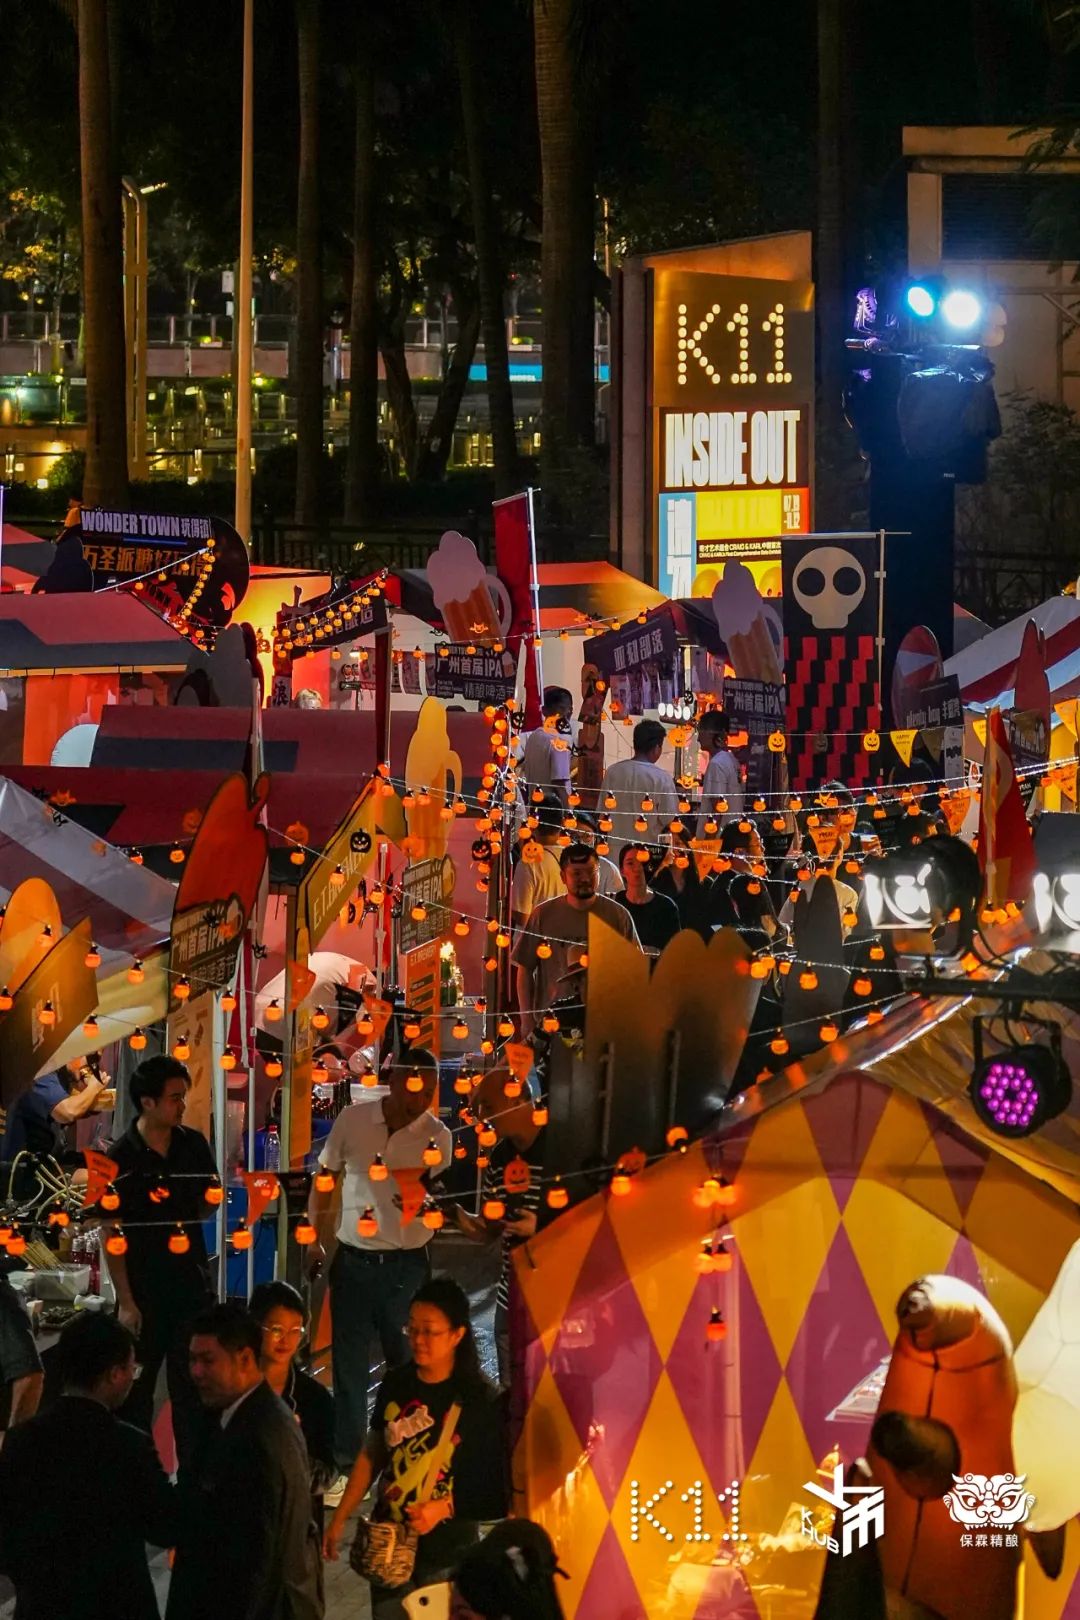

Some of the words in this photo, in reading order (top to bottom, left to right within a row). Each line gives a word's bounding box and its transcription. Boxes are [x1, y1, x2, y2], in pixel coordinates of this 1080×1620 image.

[677, 303, 792, 385] K11
[665, 411, 747, 488] INSIDE
[750, 410, 801, 486] OUT
[81, 510, 138, 535] WONDER
[139, 514, 180, 537] TOWN
[180, 517, 210, 539] 玩得镇
[436, 656, 503, 678] 广州首届IPA
